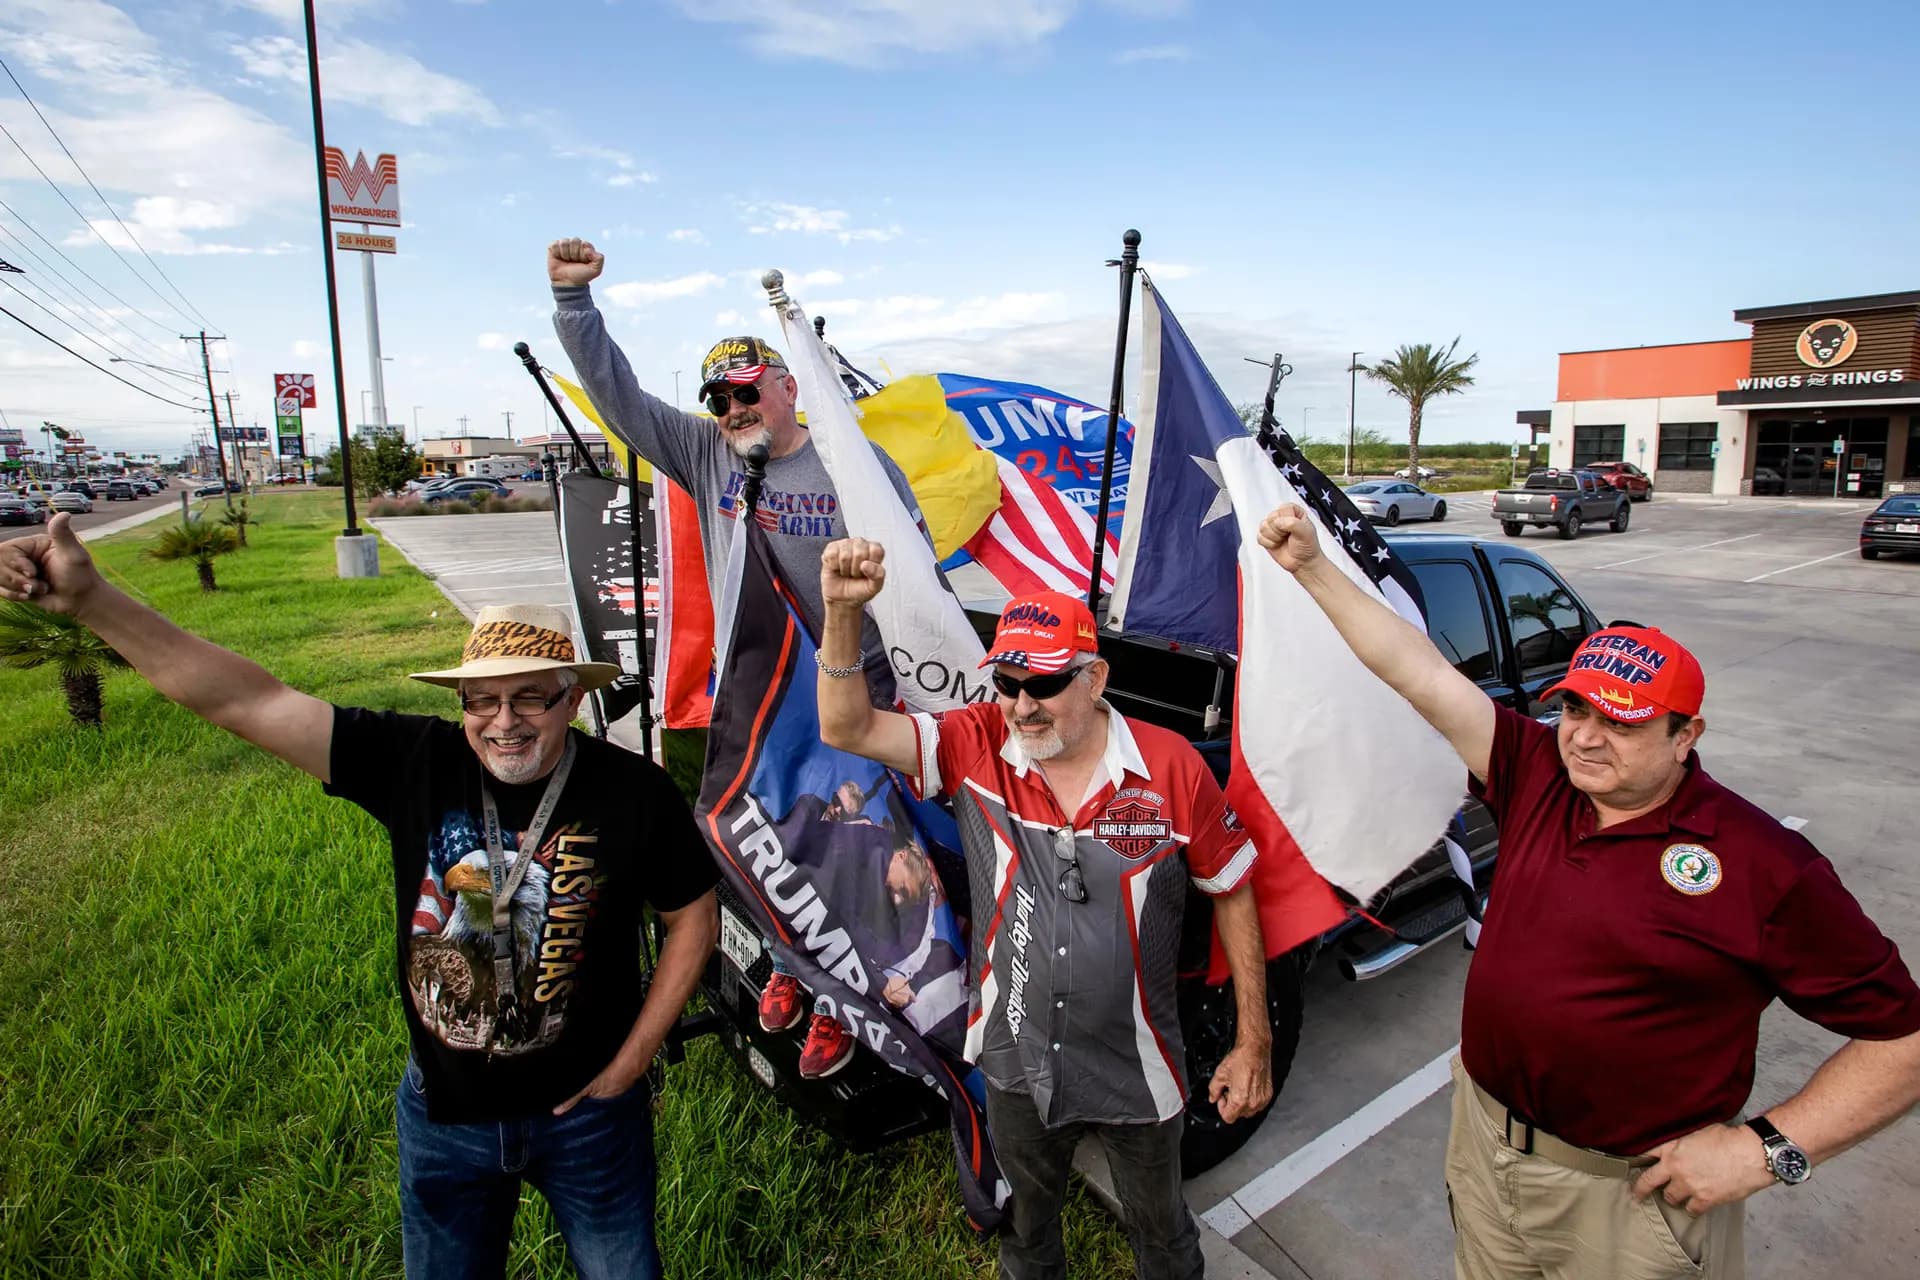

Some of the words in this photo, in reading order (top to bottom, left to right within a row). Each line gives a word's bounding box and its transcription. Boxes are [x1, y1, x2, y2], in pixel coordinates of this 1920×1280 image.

[331, 204, 398, 219] WHATABURGER
[339, 235, 353, 245] 24
[355, 236, 394, 248] HOURS
[1736, 375, 1801, 391] WINGS
[1807, 373, 1830, 387] and
[1832, 369, 1904, 386] RINGS
[779, 514, 836, 537] ARMY
[1003, 605, 1061, 628] TRUMP
[1033, 629, 1056, 640] GREAT
[1584, 635, 1668, 672] VETERAN
[1604, 647, 1621, 658] FOR
[890, 646, 999, 705] COM
[1572, 653, 1654, 686] TRUMP
[1612, 705, 1655, 719] PRESIDENT
[1116, 809, 1151, 821] MOTOR
[1098, 823, 1167, 837] HARLEY-DAVIDSON
[1114, 840, 1152, 855] CYCLES
[551, 835, 599, 896] LAS
[730, 792, 869, 996] TRUMP
[733, 919, 748, 941] TEXAS
[534, 900, 591, 1003] VEGAS
